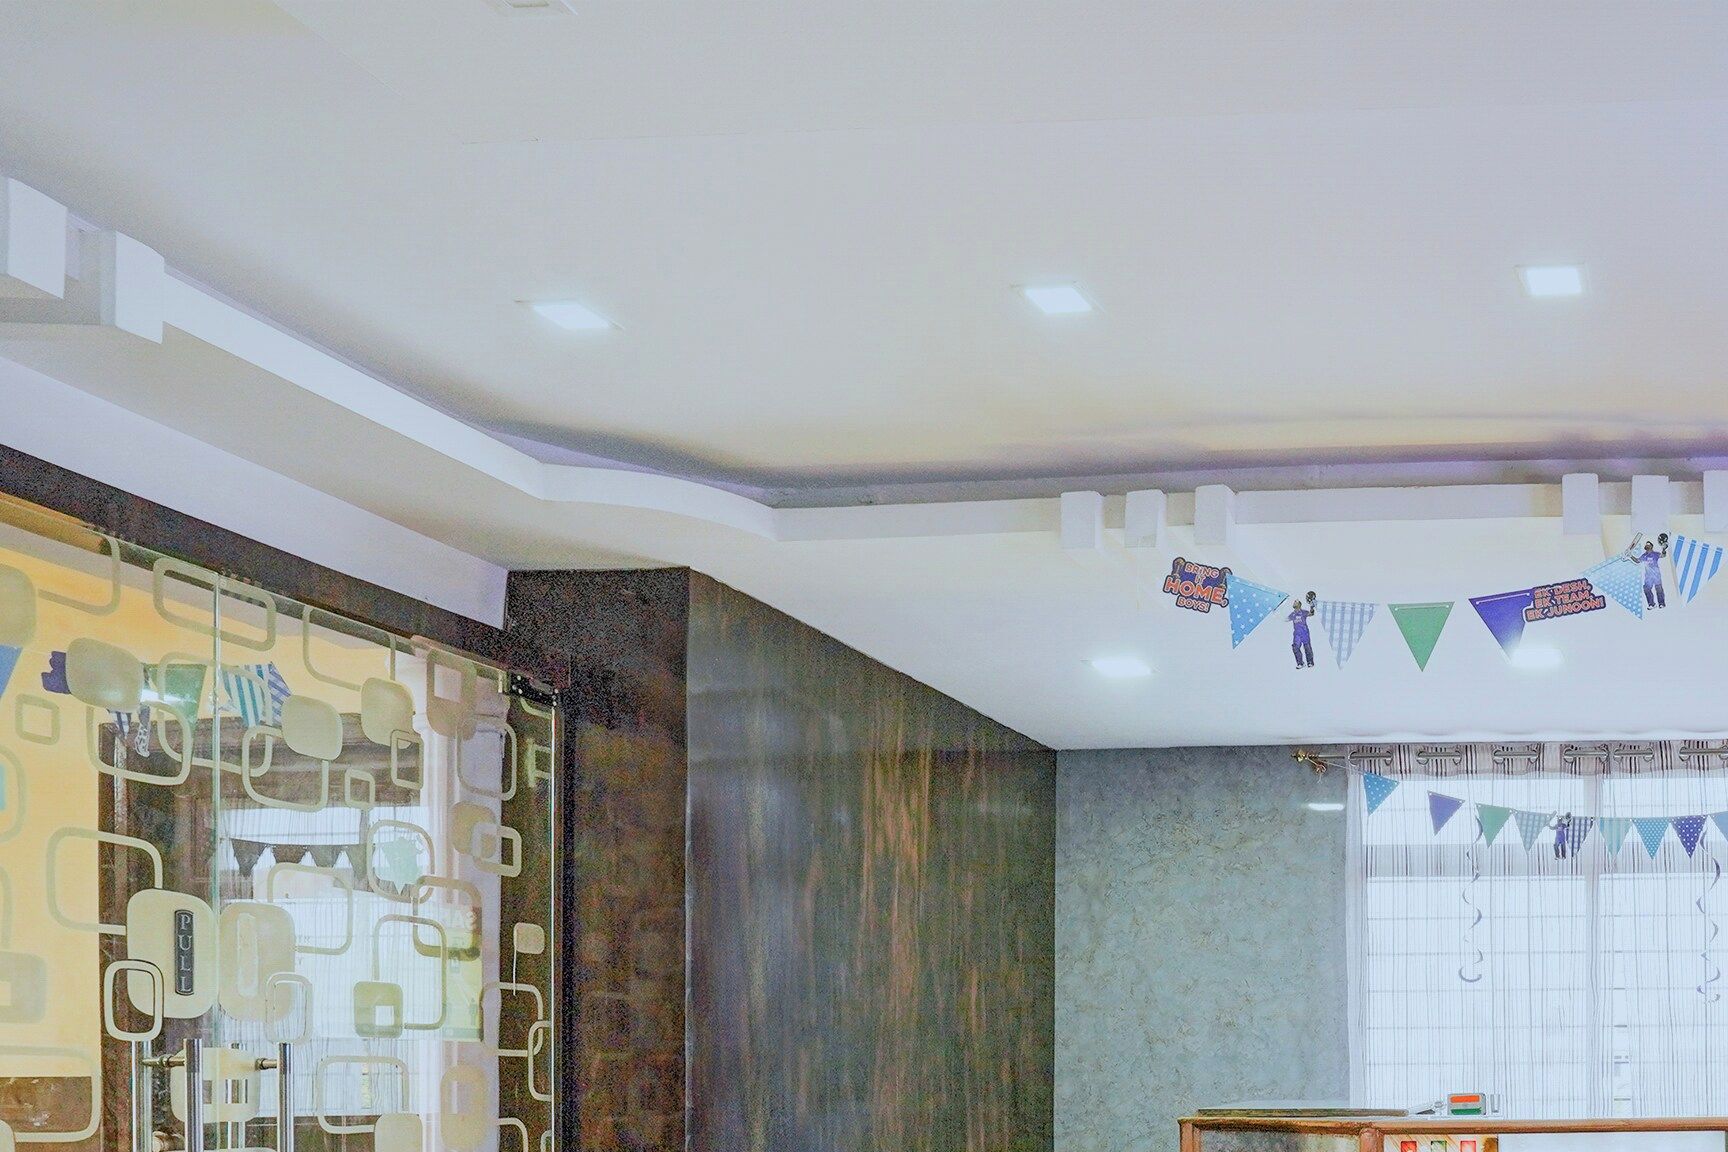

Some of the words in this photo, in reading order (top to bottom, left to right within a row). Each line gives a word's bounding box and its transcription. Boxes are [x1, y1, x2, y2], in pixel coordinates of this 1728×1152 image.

[1185, 562, 1219, 578] BRING
[1165, 576, 1228, 607] HOME,
[1177, 596, 1210, 613] BOYS!
[1547, 597, 1605, 617] JUNOON!
[179, 914, 193, 992] PULL
